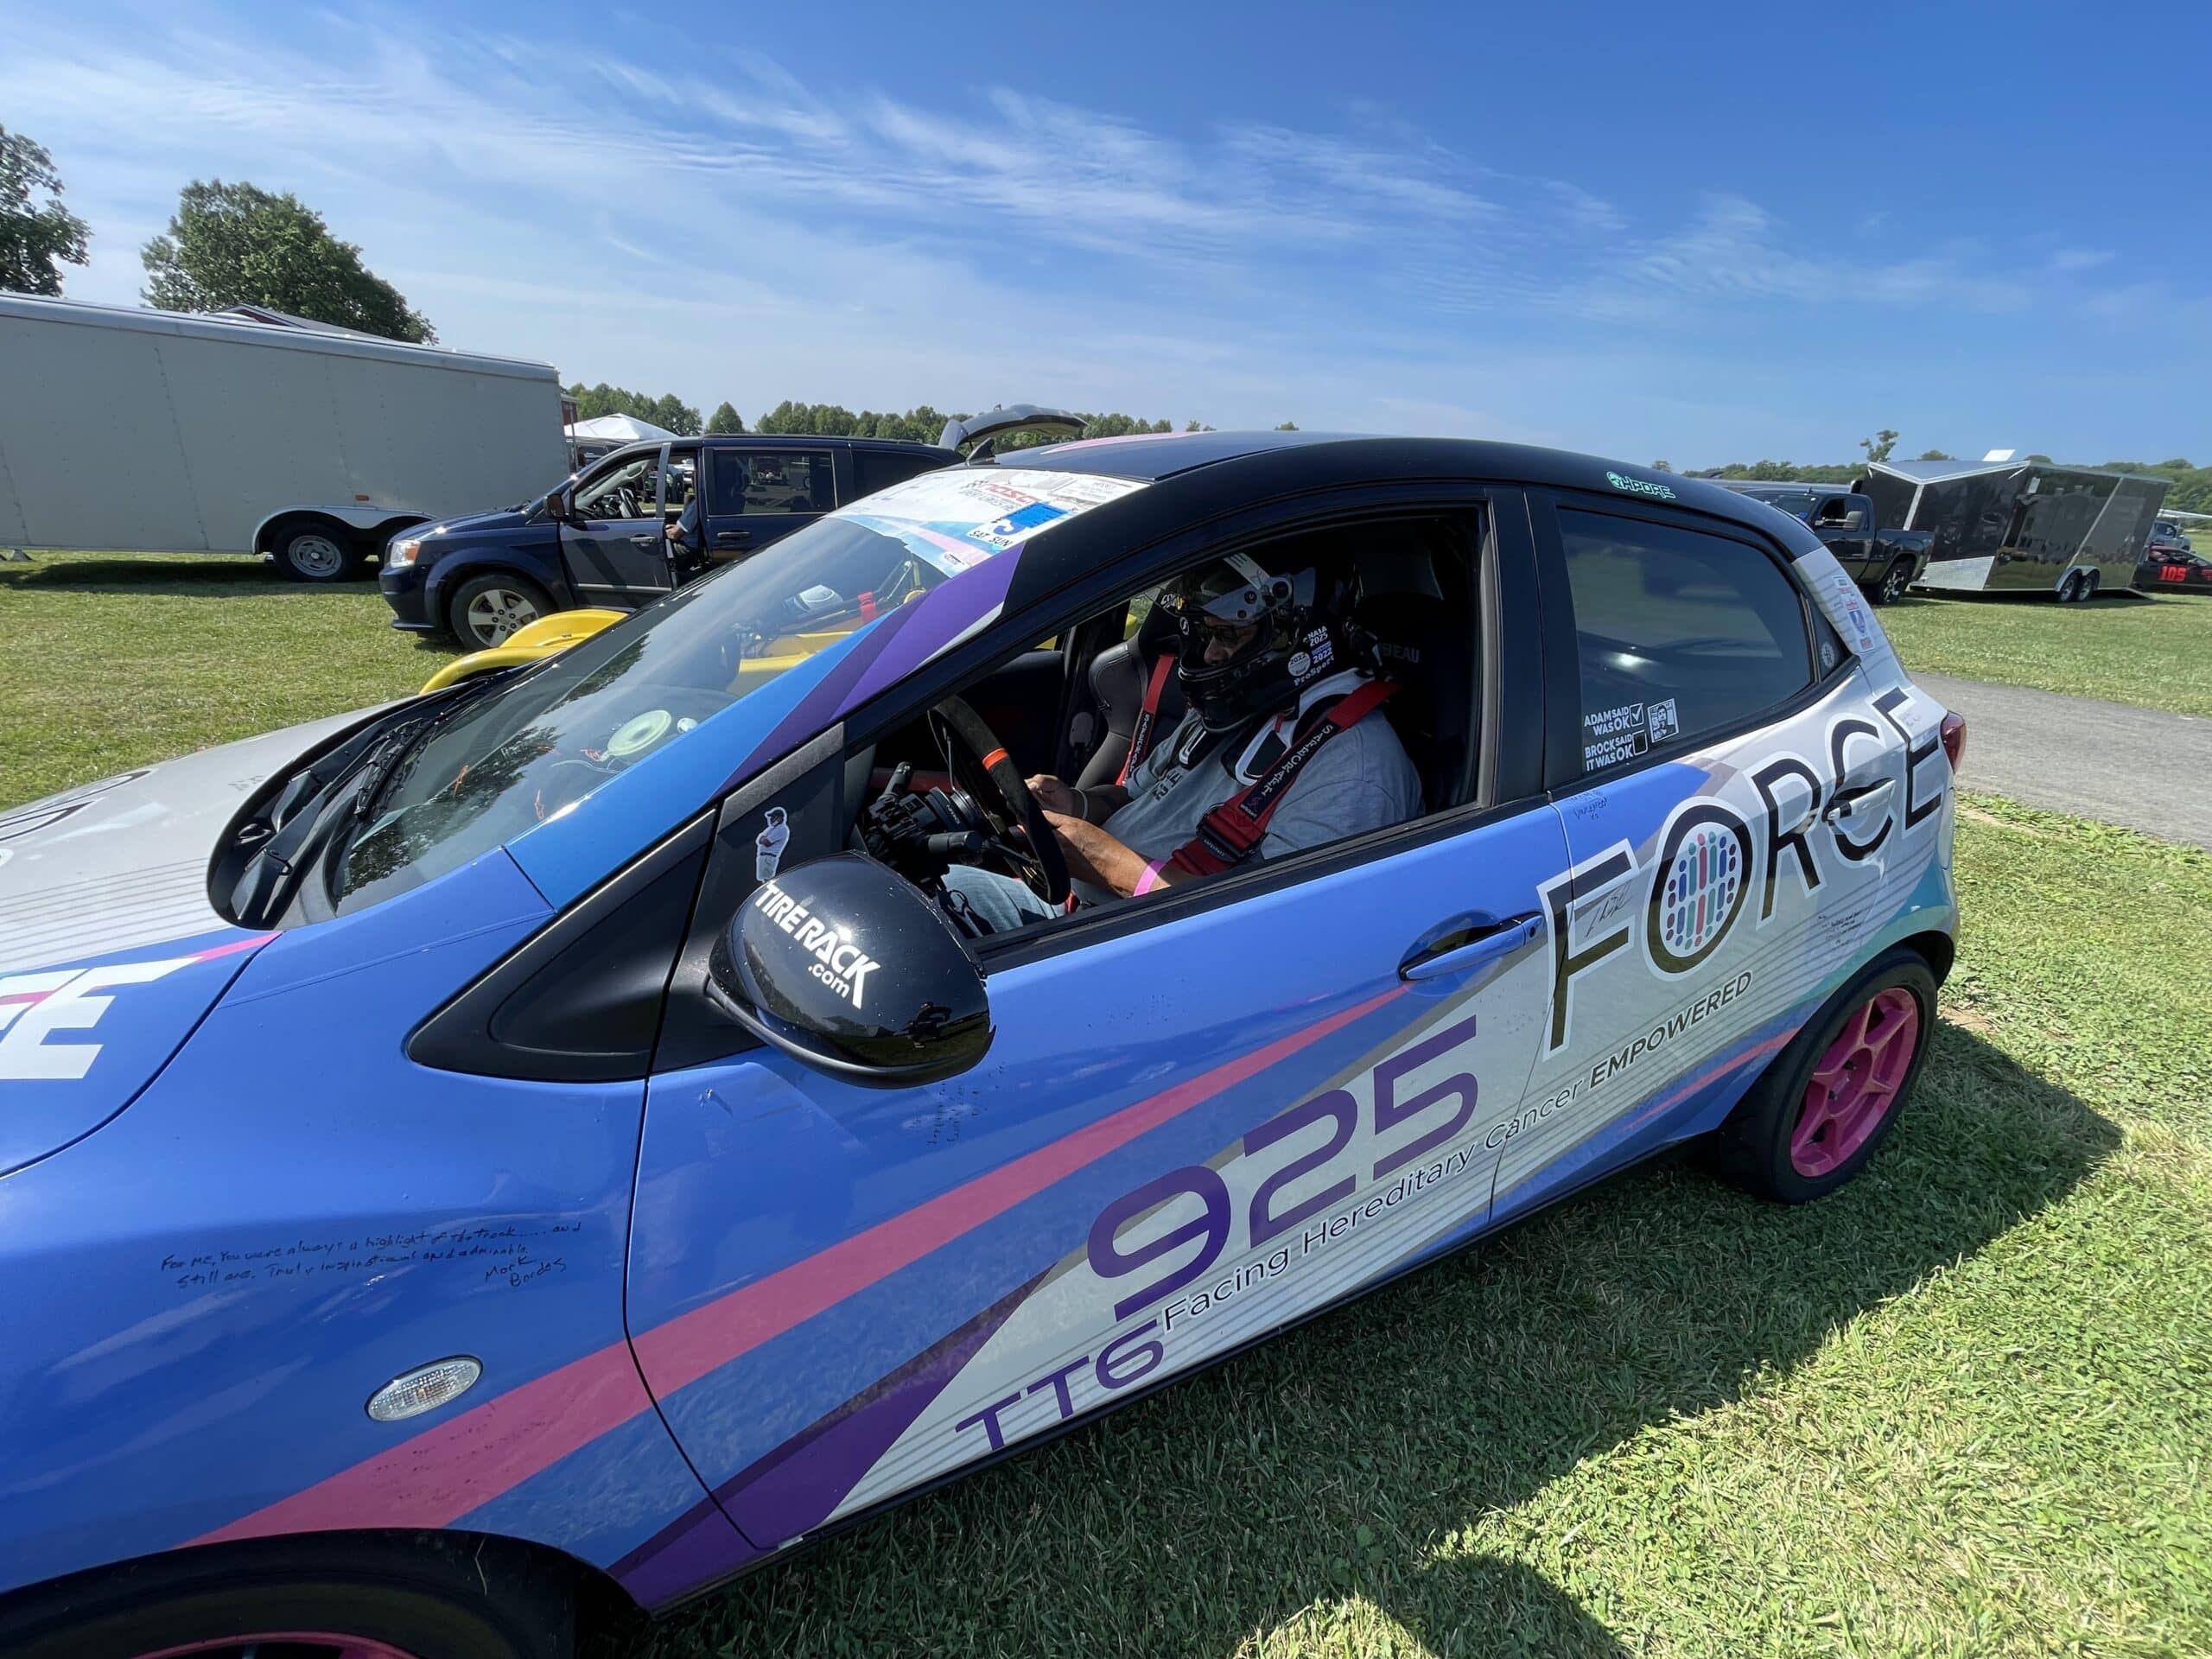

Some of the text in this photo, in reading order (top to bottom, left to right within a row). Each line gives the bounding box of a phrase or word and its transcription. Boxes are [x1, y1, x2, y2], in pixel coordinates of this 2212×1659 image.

[969, 530, 1014, 547] SAT SUN
[1584, 707, 1630, 727] ADAM SAID
[1593, 716, 1630, 736] WAS OK
[1262, 724, 1333, 797] SAFECRAFT
[1585, 734, 1632, 759] BROCK SAID
[1586, 746, 1633, 771] IT WAS OK
[1541, 686, 1943, 1056] FORCE
[755, 880, 881, 1009] TIRE RACK
[808, 964, 852, 998] .com
[1590, 972, 1751, 1090] EMPOWERED
[1087, 1014, 1478, 1321] 925
[1163, 1078, 1583, 1332] Facing Hereditary Cancer
[365, 1230, 429, 1249] highlight
[956, 1320, 1164, 1452] TT6
